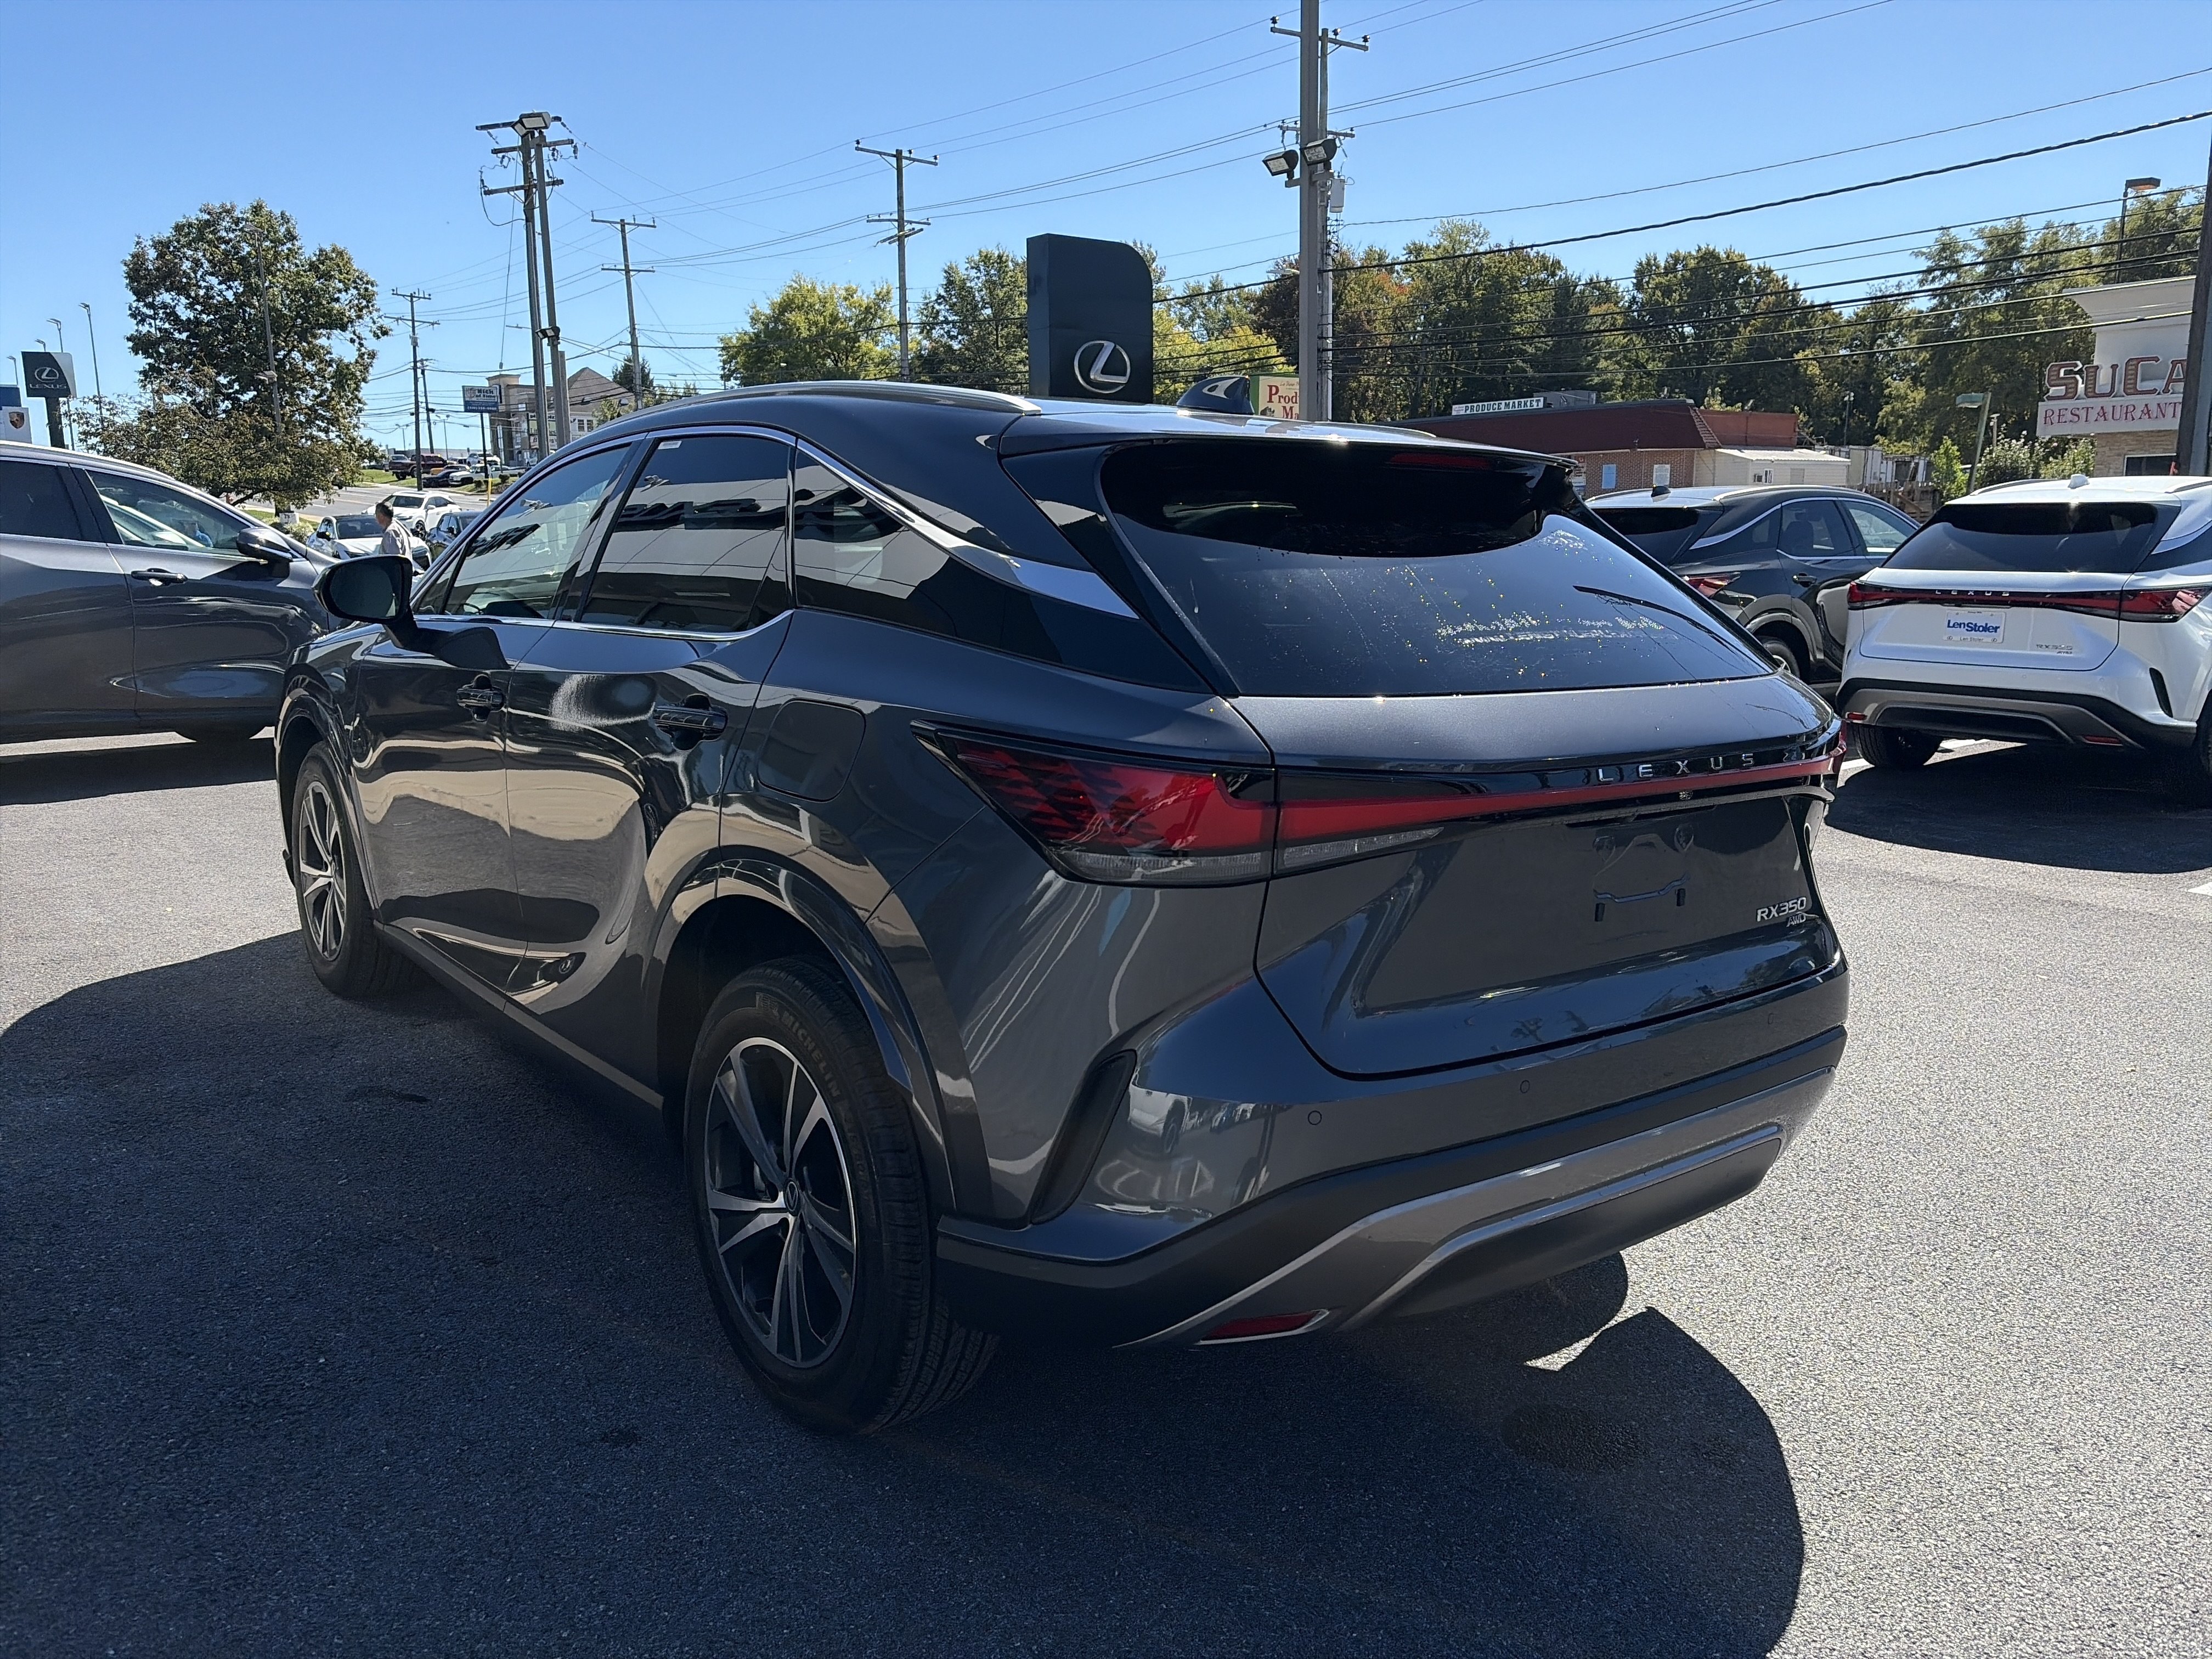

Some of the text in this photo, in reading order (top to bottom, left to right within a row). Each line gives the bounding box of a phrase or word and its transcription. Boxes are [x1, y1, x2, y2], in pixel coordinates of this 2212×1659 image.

[1267, 385, 1299, 404] Prod
[1282, 405, 1299, 420] Ma
[1464, 402, 1502, 413] PRODUCE
[1504, 398, 1541, 410] MARKET
[2043, 402, 2183, 426] RESTAURANT
[1598, 753, 1754, 782] LEXUS
[1757, 897, 1807, 922] RX350
[1786, 912, 1807, 928] AWD
[781, 1010, 841, 1097] MICHELIN
